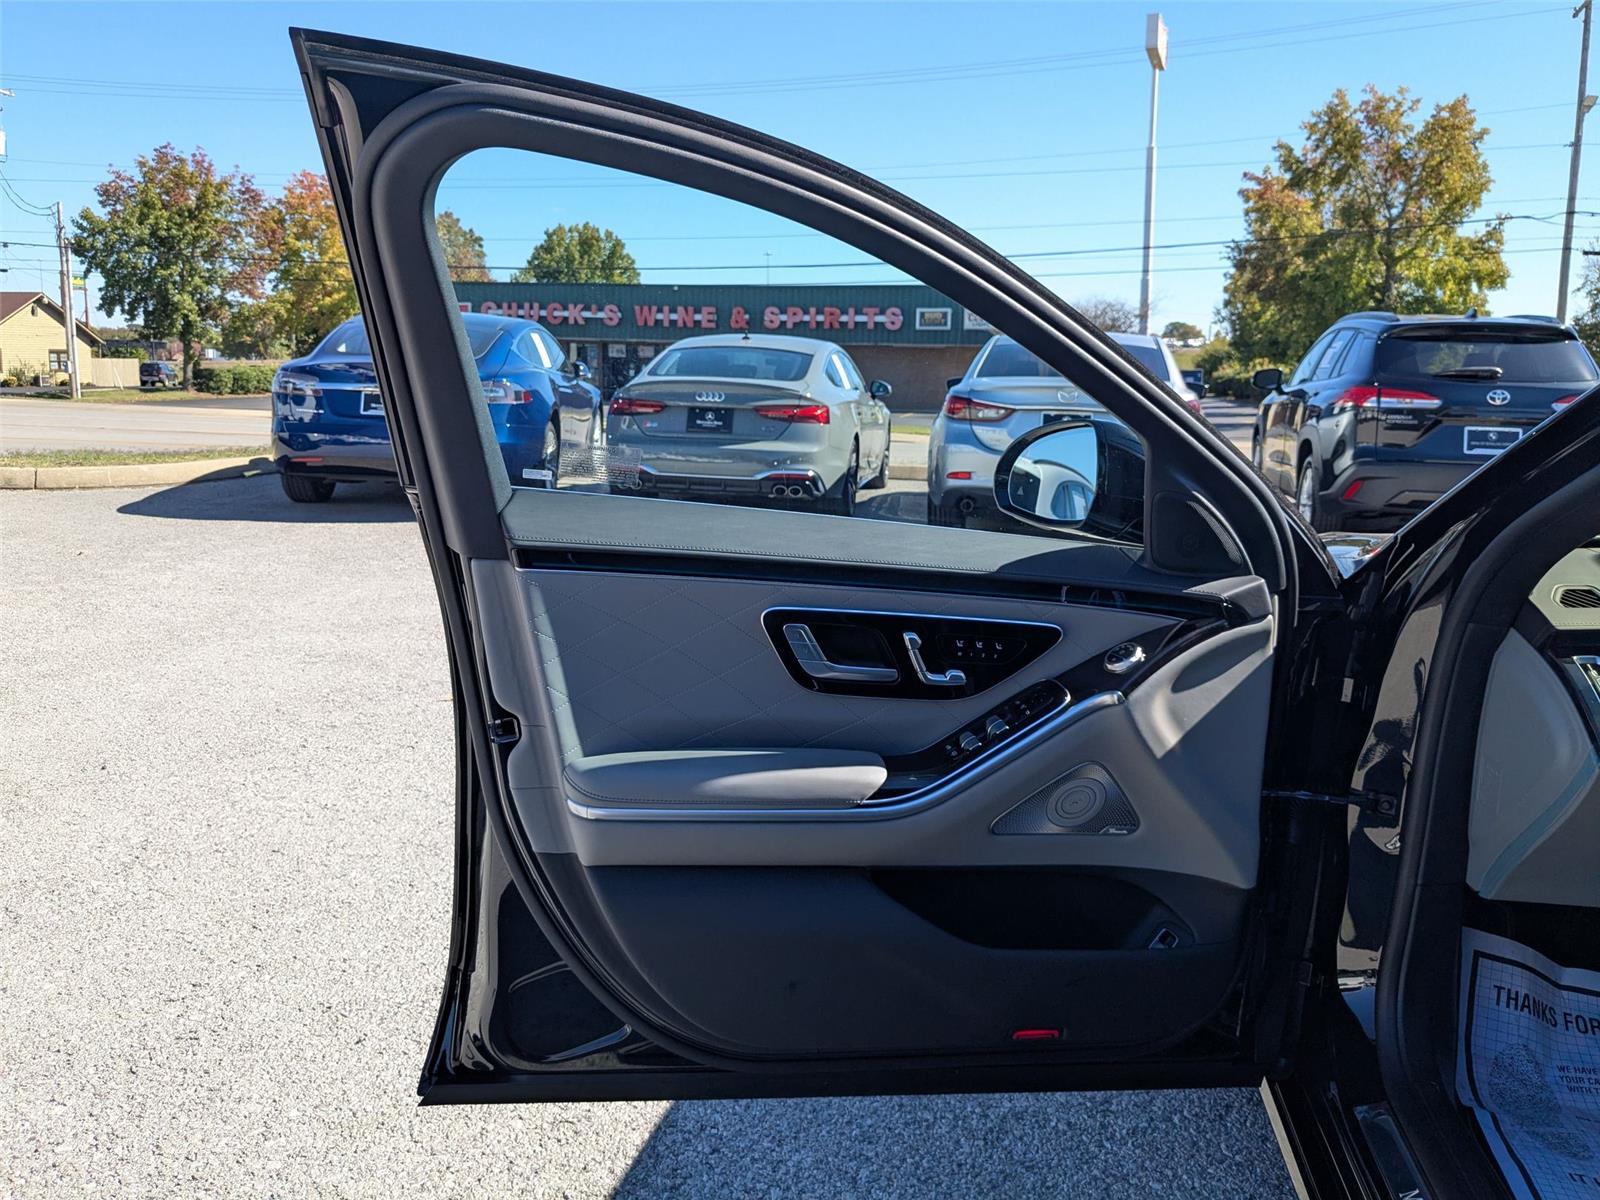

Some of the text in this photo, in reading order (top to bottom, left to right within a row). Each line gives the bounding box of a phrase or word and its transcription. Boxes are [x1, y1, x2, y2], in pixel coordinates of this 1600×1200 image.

[480, 301, 903, 331] CHUCK'S WINE & SPIRITS
[1493, 984, 1600, 1036] THANKS FOR
[1556, 1064, 1598, 1075] WE HAVE
[1558, 1075, 1586, 1084] YOUR
[1567, 1085, 1592, 1094] WITH
[1568, 1172, 1588, 1184] IT
